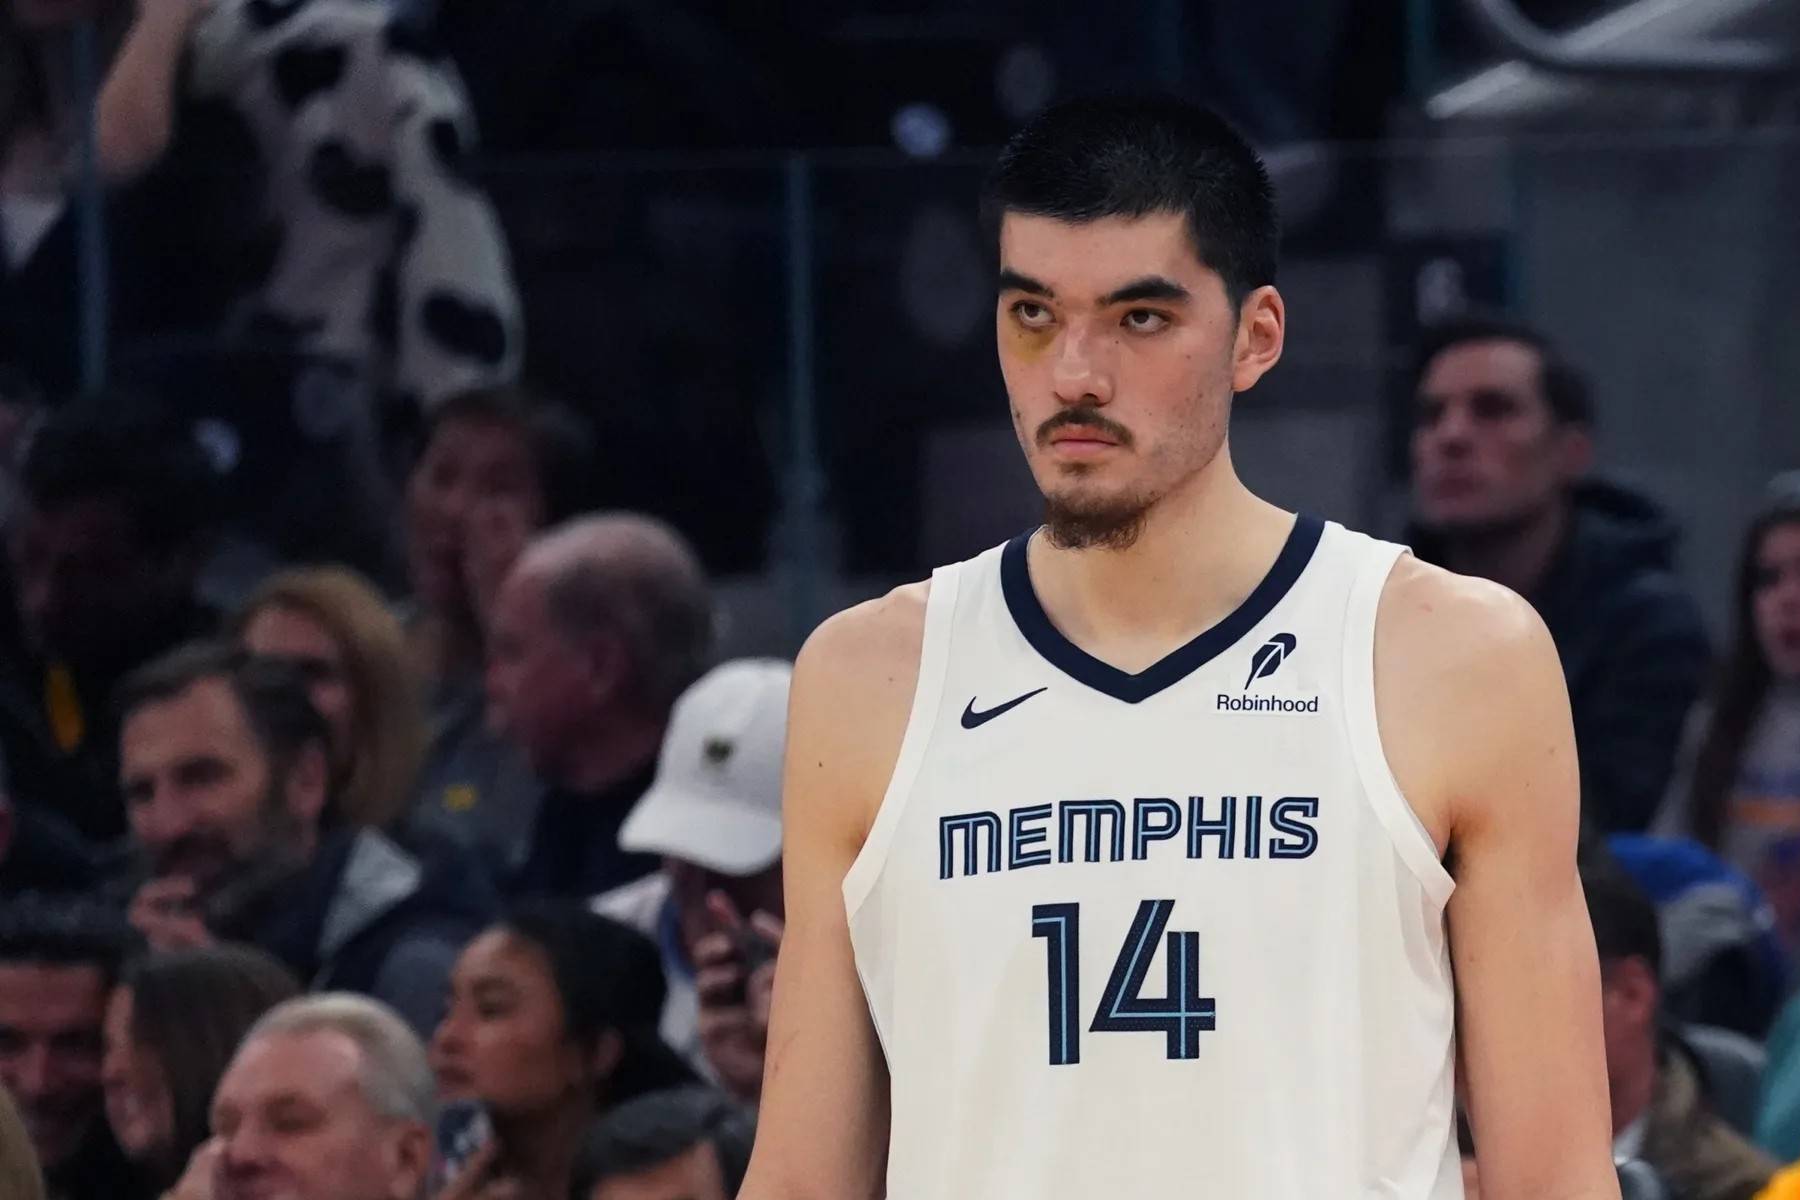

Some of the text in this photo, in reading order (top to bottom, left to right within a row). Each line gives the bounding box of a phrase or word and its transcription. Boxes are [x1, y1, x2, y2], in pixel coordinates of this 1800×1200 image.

[1216, 693, 1319, 714] Robinhood
[940, 796, 1319, 879] MEMPHIS
[1032, 899, 1215, 1065] 14
